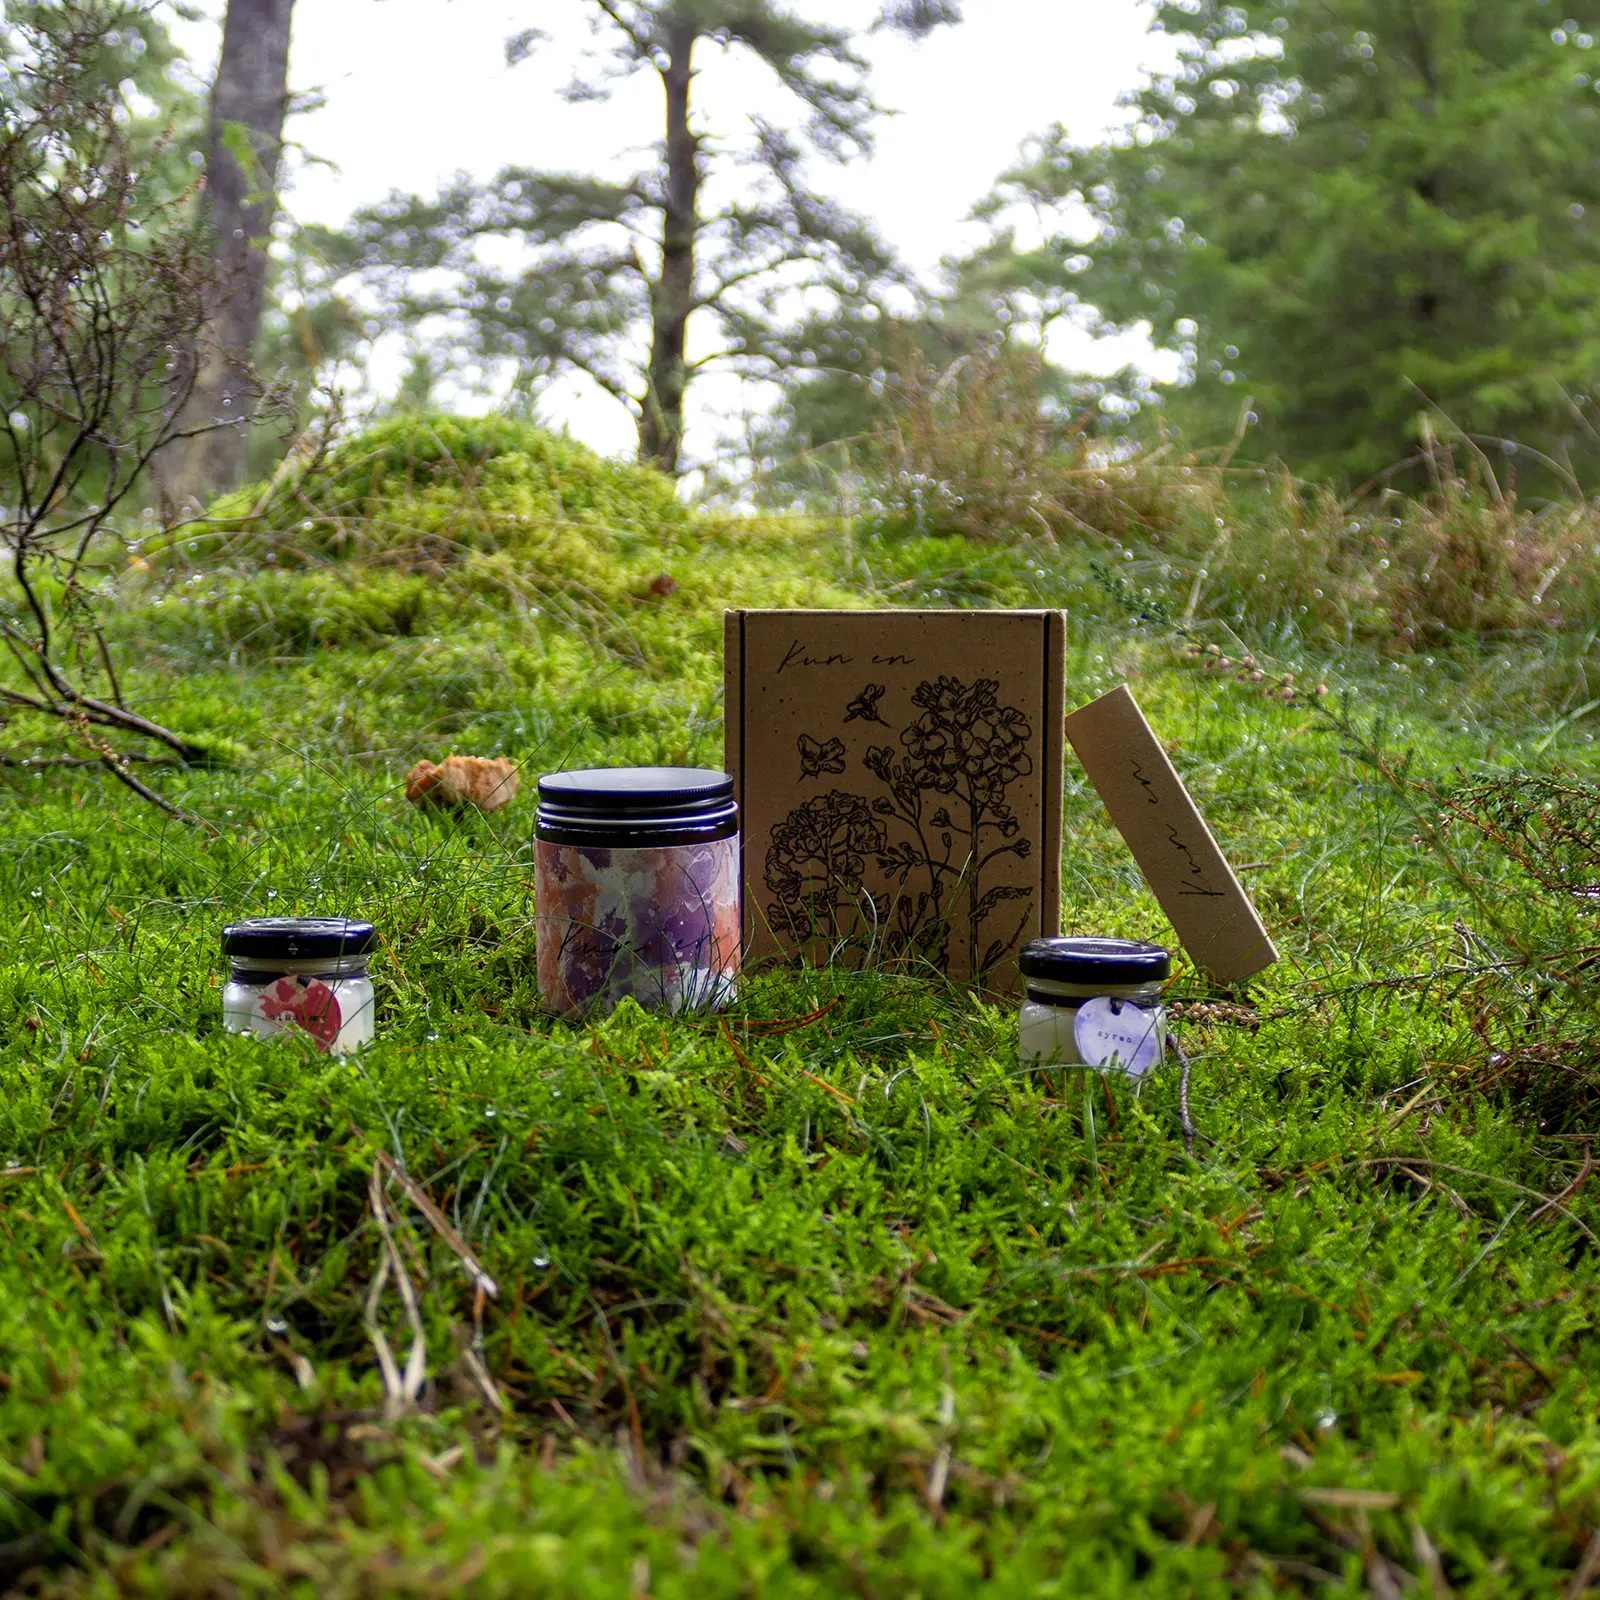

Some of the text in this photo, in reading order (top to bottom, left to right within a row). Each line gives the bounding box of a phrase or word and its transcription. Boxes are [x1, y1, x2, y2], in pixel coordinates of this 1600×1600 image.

[776, 639, 917, 674] Kun en
[1130, 759, 1226, 896] Kun en
